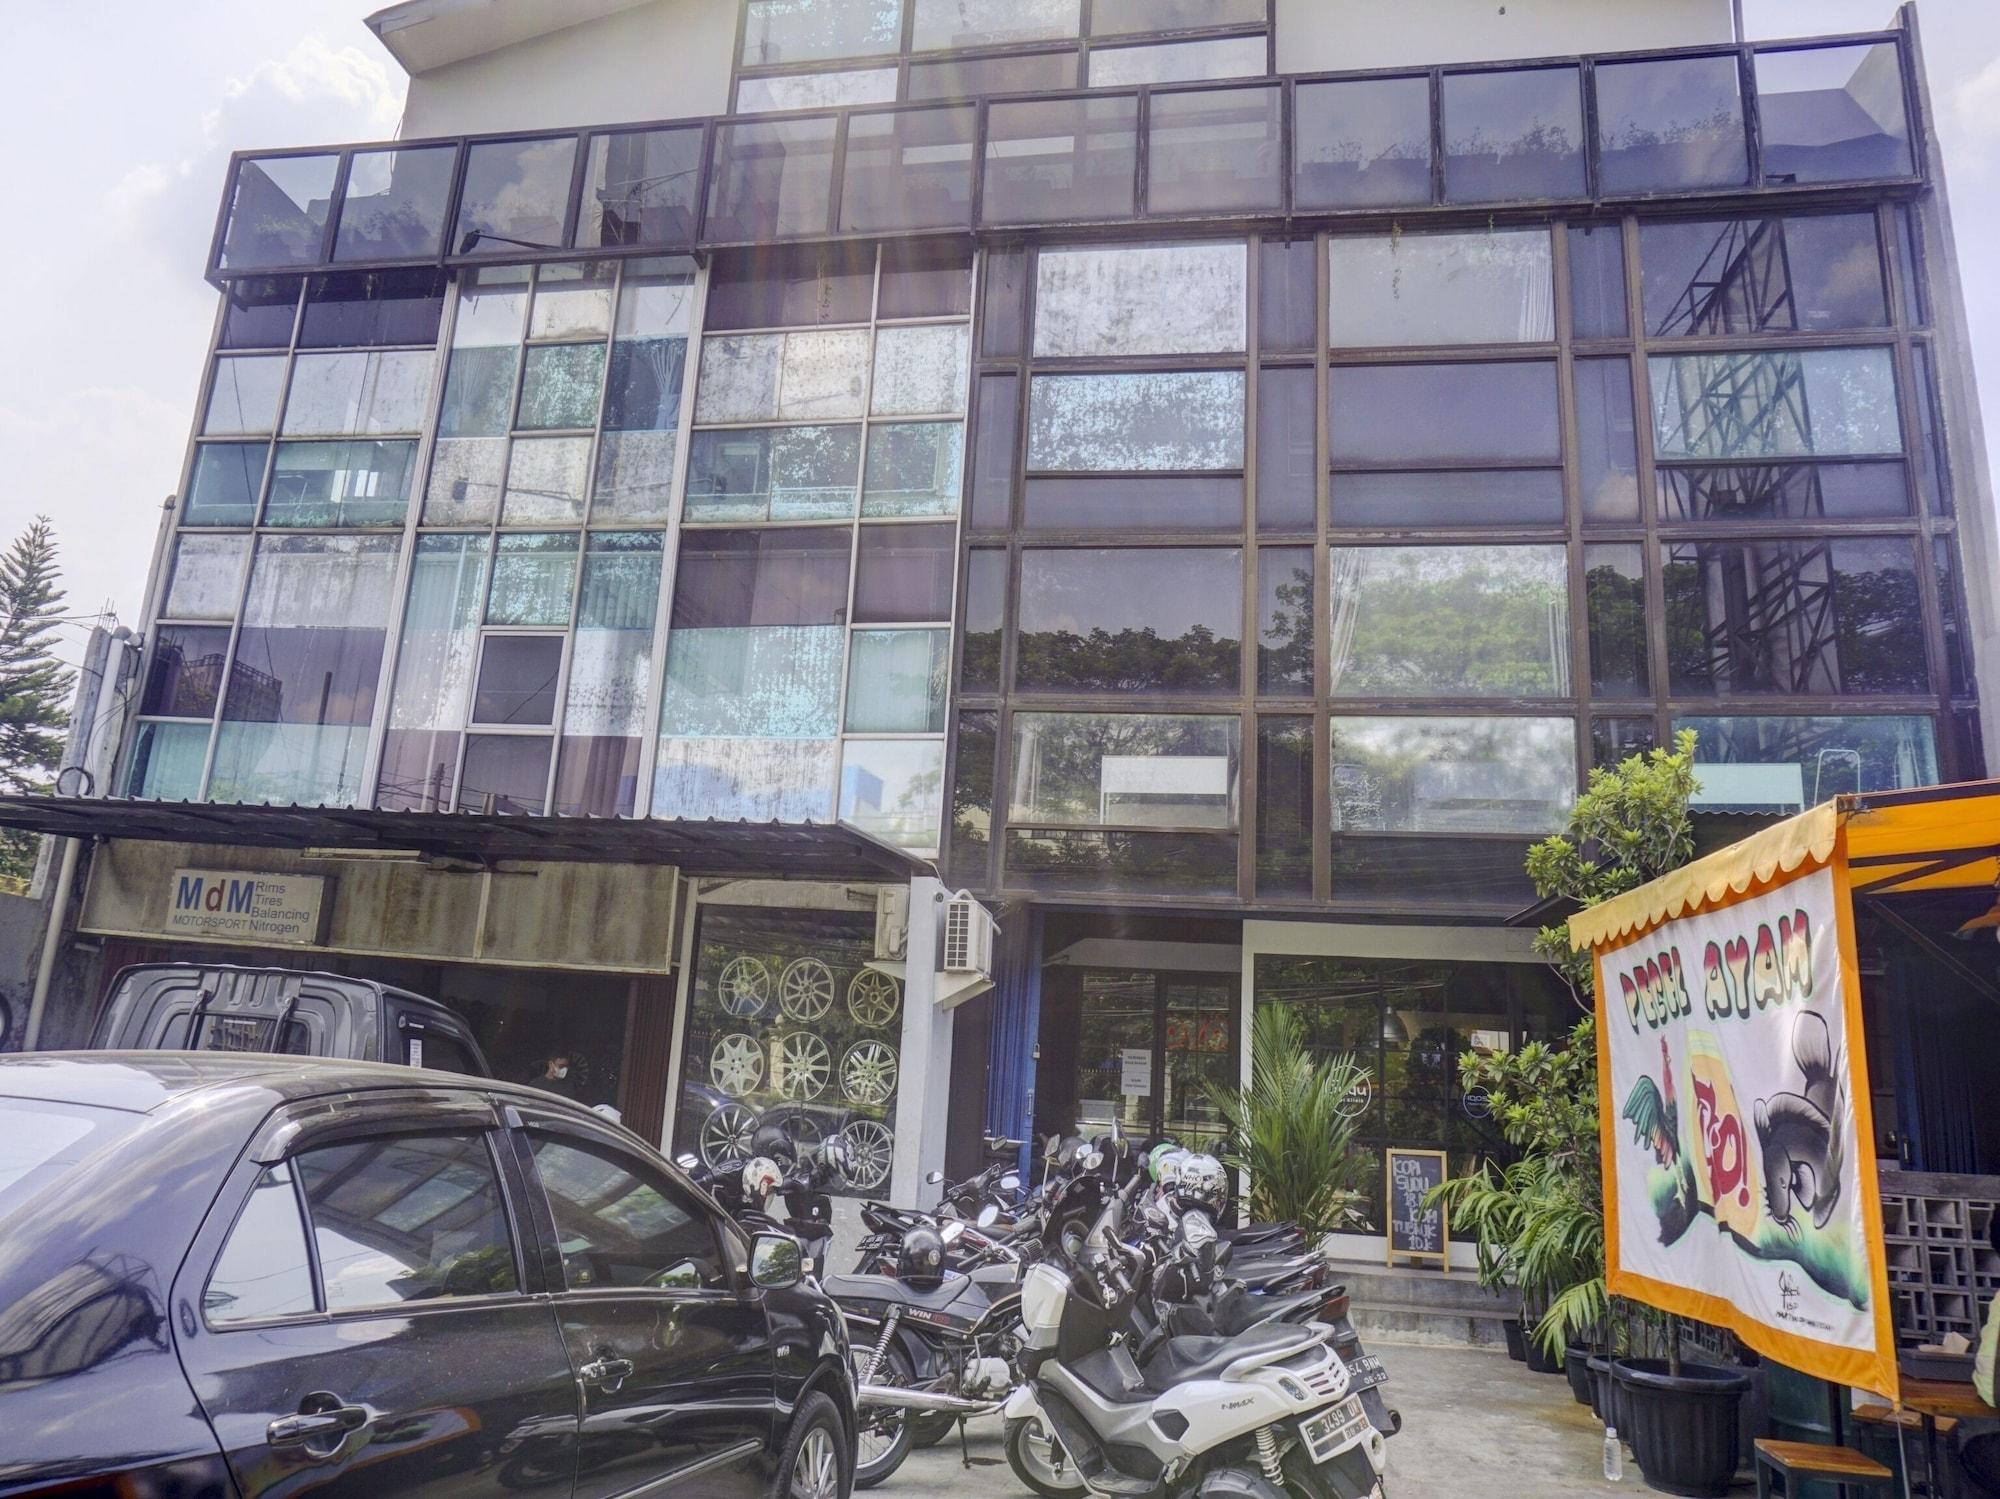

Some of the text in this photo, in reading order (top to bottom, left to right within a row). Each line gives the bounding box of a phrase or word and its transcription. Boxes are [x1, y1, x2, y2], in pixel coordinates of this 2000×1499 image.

[255, 881, 286, 894] Rims
[254, 893, 283, 906] Tires
[172, 914, 248, 929] MOTORSPORT
[250, 907, 310, 923] Balancing
[249, 919, 300, 935] Nitrogen
[1620, 908, 1813, 1035] PECEL AYAM
[906, 1308, 932, 1319] WIN
[1307, 1426, 1315, 1442] F
[1321, 1408, 1345, 1433] 3499
